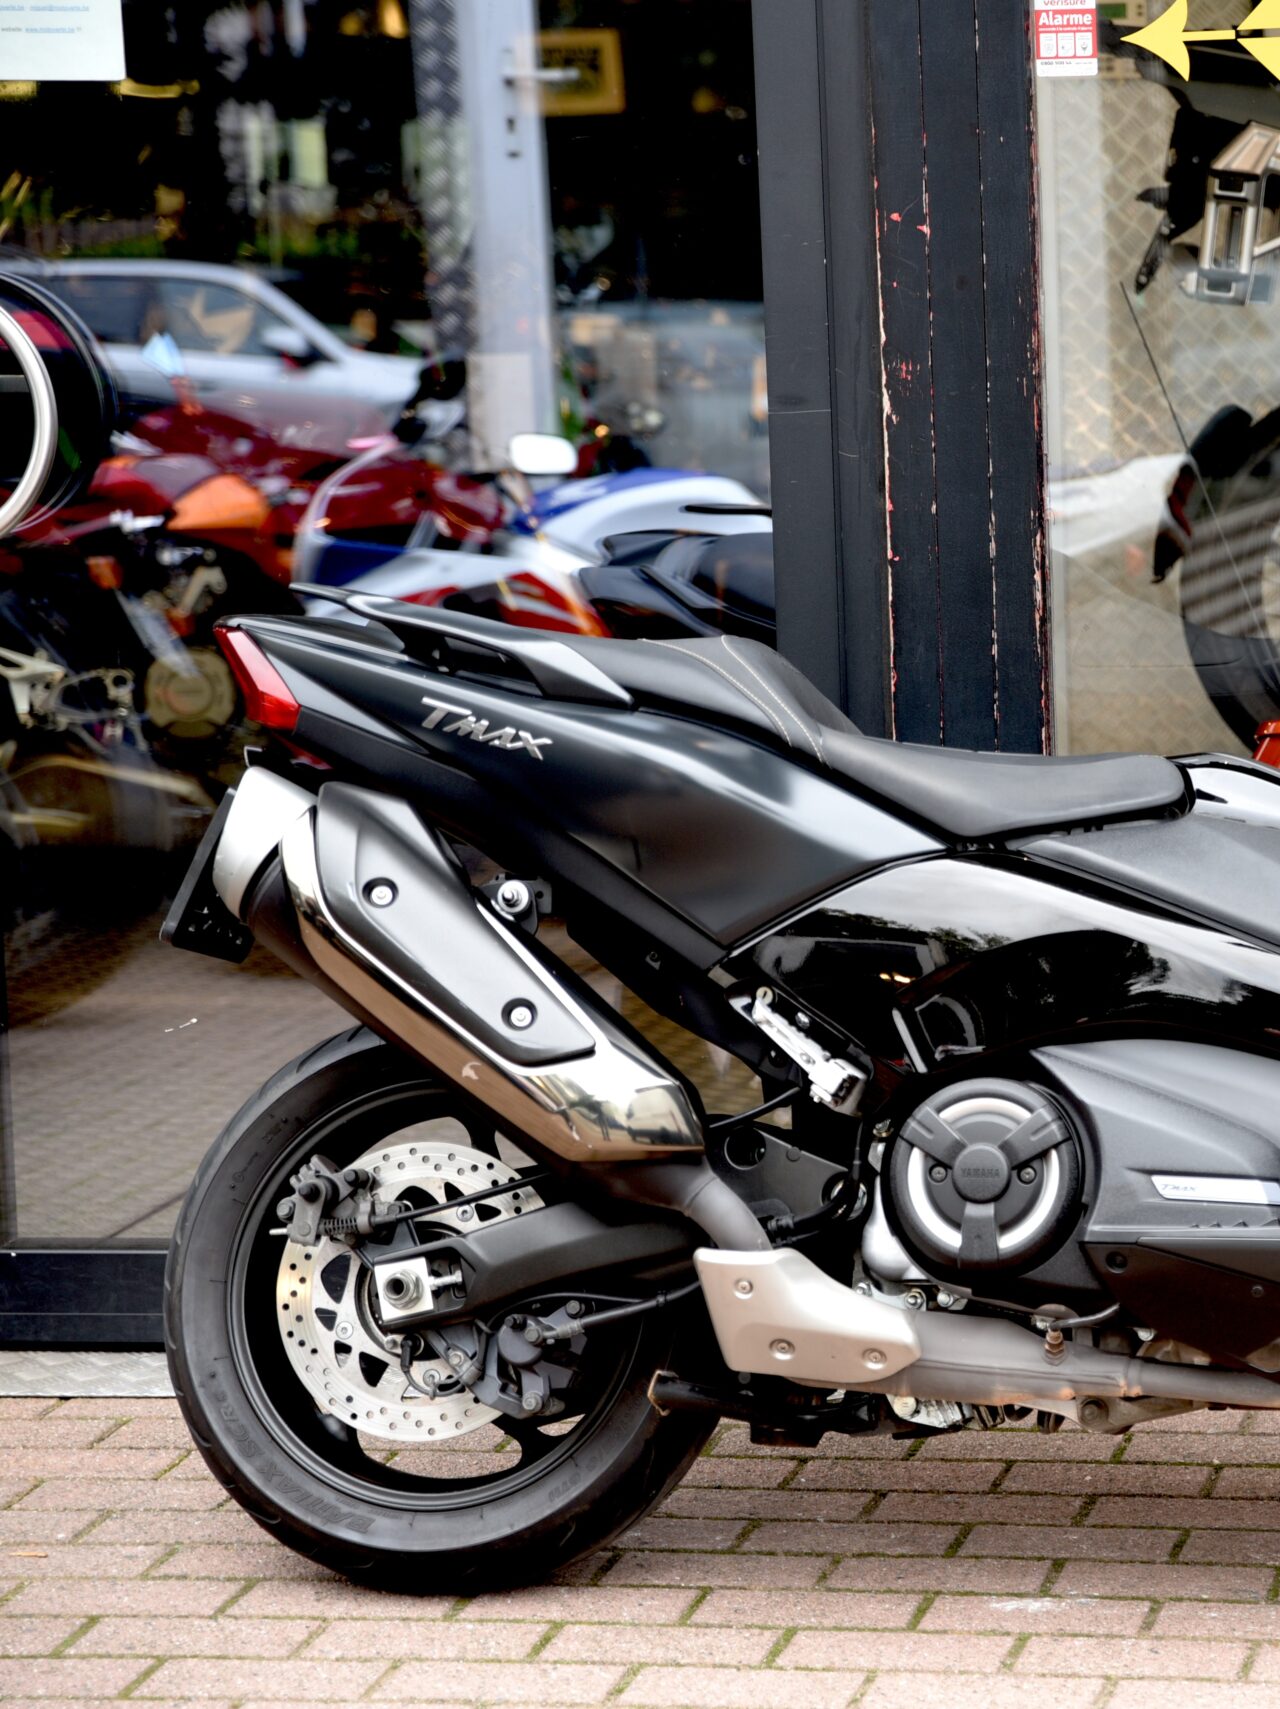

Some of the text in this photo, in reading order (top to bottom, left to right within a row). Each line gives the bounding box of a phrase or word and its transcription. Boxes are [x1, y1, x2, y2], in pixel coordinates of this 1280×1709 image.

[1038, 11, 1093, 26] Alarme
[421, 696, 553, 760] TMAX
[960, 1167, 1000, 1178] YAMAHA
